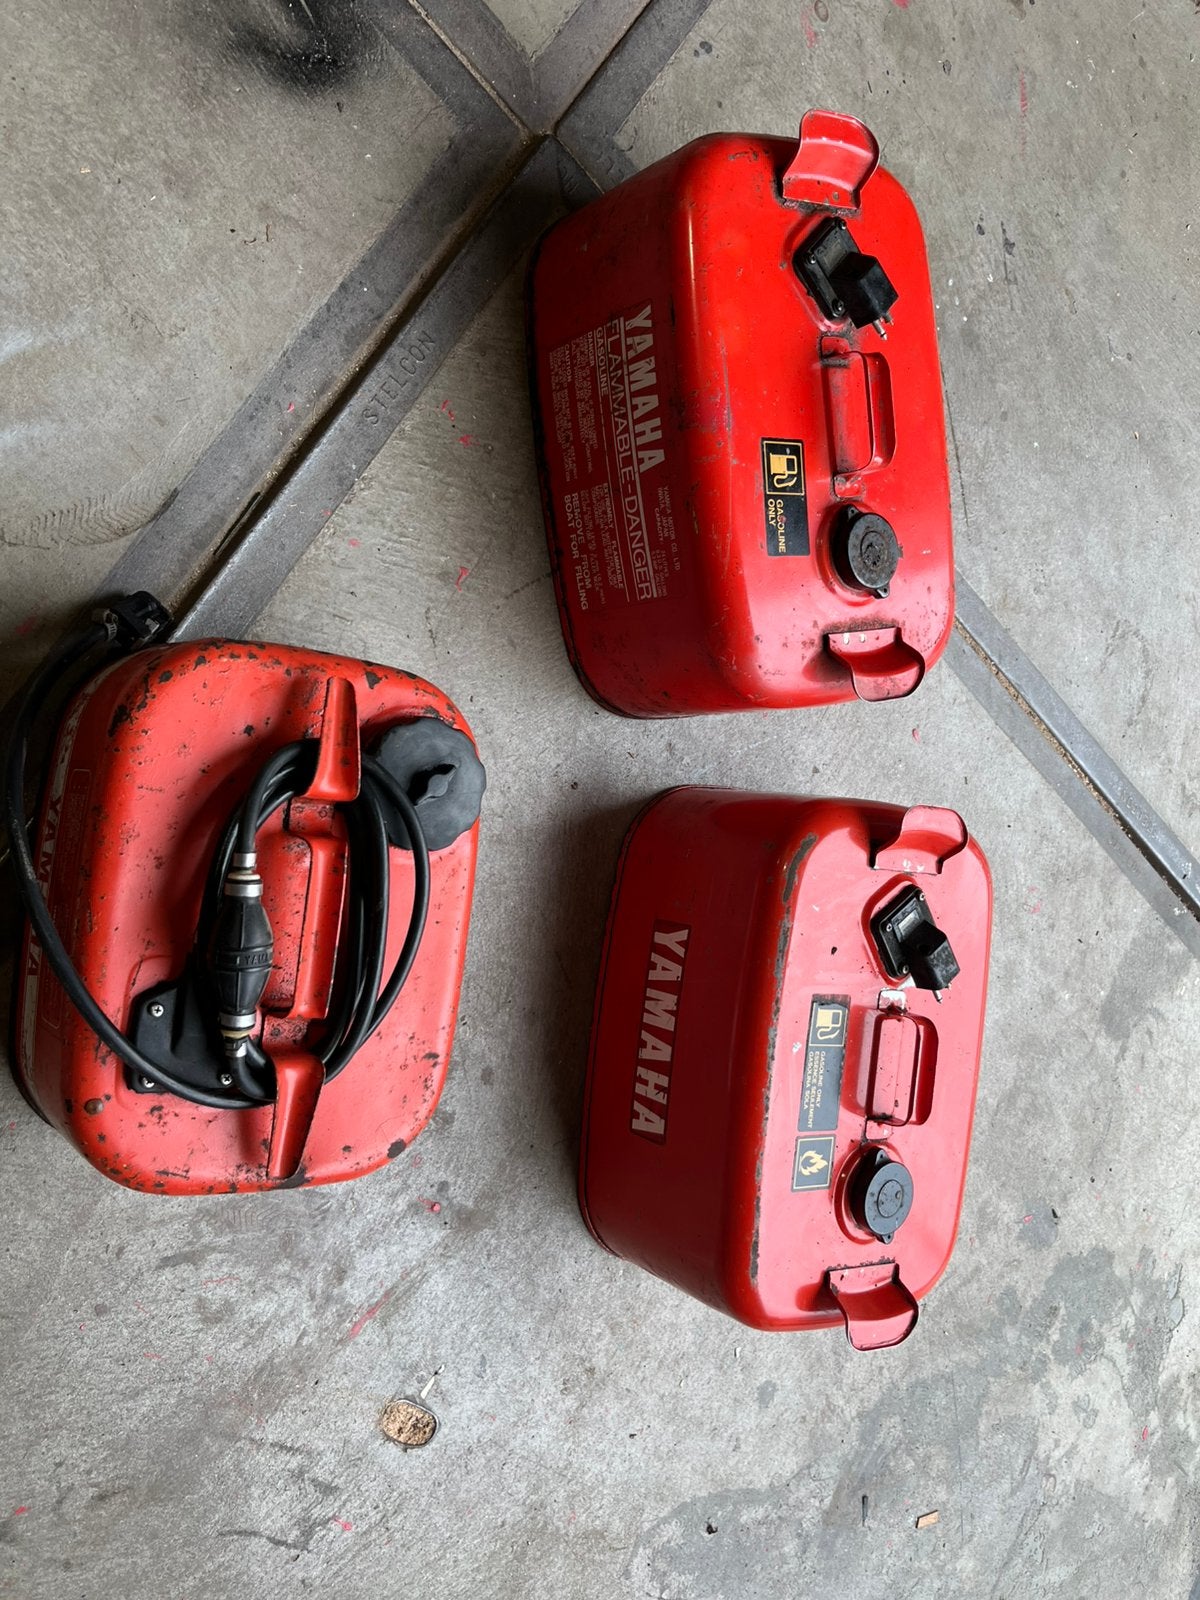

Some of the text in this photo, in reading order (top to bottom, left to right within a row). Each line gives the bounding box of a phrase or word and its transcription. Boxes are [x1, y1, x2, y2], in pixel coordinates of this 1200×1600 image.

[564, 343, 572, 382] CAUTION
[587, 330, 595, 367] DANGER
[596, 327, 608, 396] GASOLINE
[361, 330, 435, 424] STELCON
[625, 304, 665, 474] YAMAHA
[563, 494, 575, 528] BOAT
[602, 482, 614, 529] EXTREMELY
[611, 540, 624, 589] FLAMMABLE
[767, 498, 777, 527] ONLY
[776, 499, 786, 553] GASOLINE
[569, 533, 580, 559] FOR
[570, 491, 592, 589] REMOVE FROM
[574, 565, 589, 611] FILLING
[27, 795, 63, 976] YAMA
[631, 928, 689, 1135] YAMAHA
[806, 1051, 814, 1088] GASOLINA
[807, 1050, 820, 1128] ESSENCE SEULEMENT
[818, 1051, 826, 1087] GASOLINE
